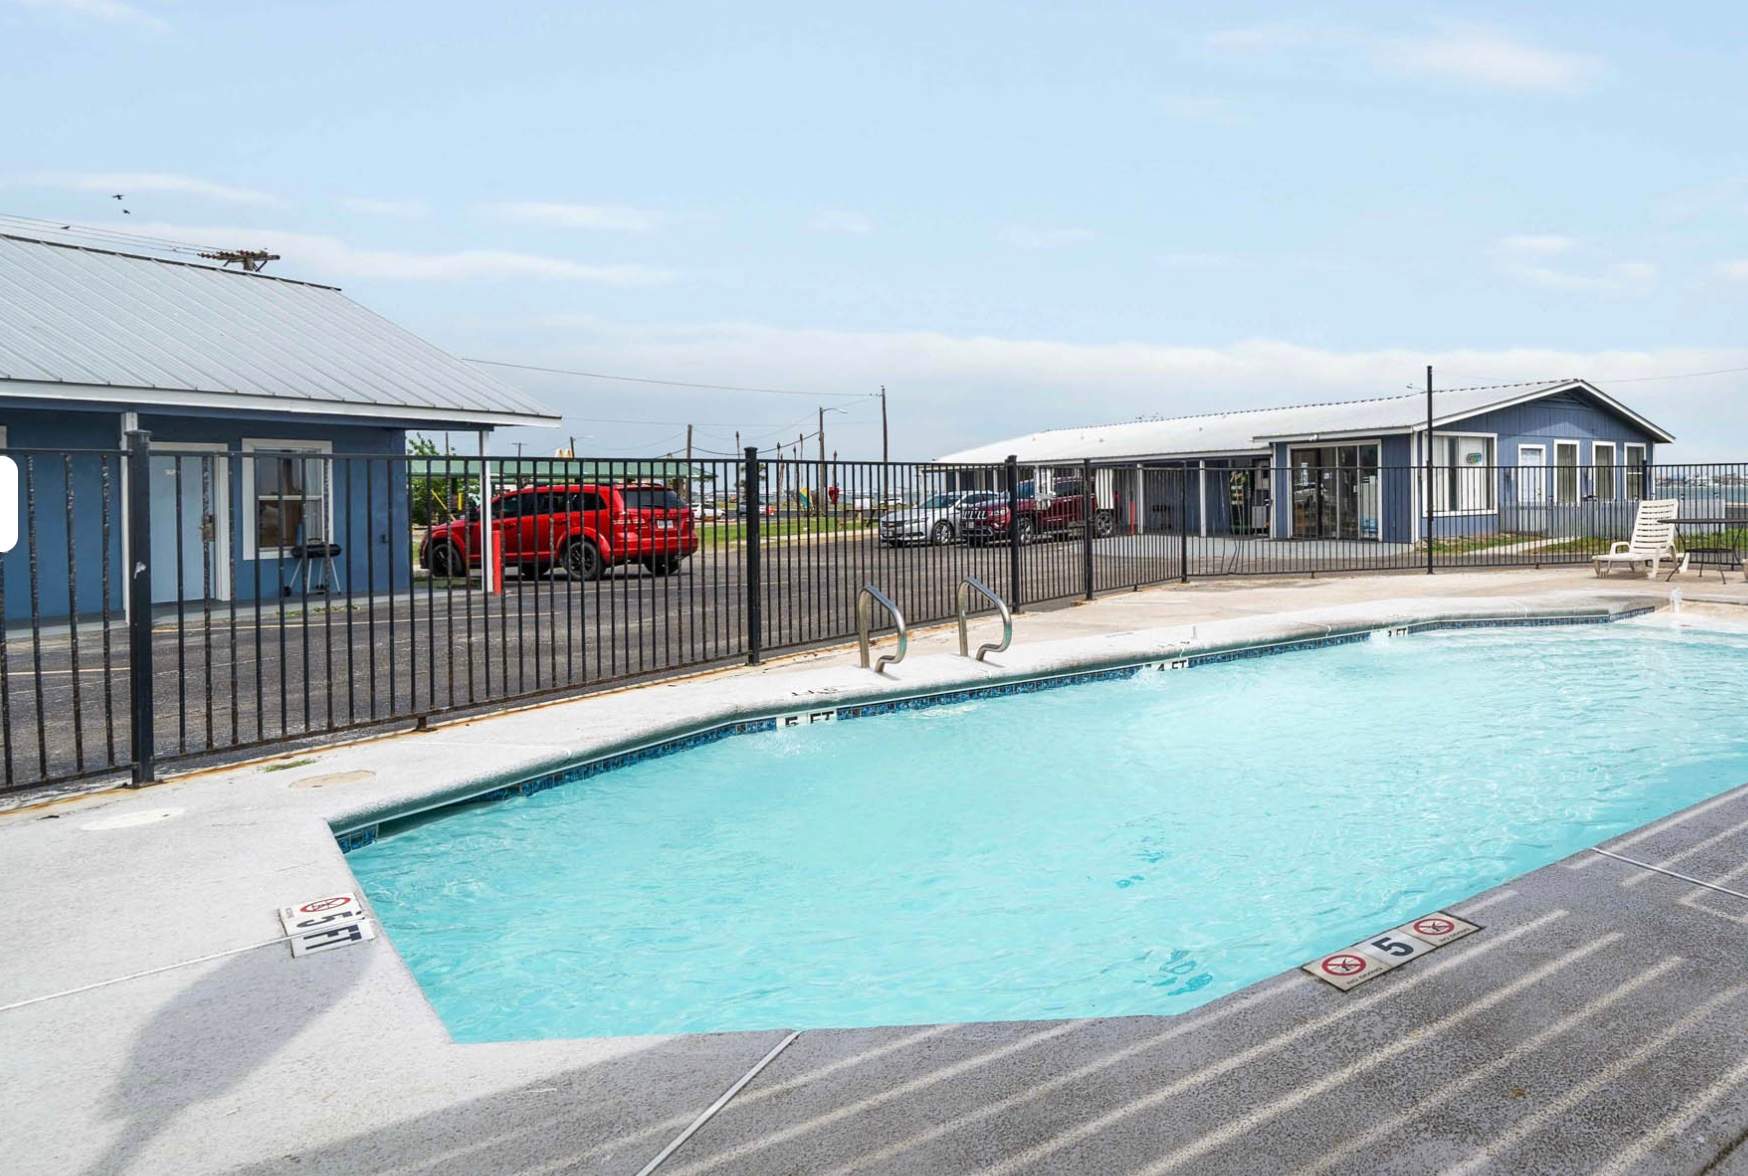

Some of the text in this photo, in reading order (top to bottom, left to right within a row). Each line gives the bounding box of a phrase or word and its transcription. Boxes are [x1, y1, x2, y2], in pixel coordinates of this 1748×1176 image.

[810, 711, 834, 724] FT
[303, 924, 362, 951] FT
[1371, 937, 1415, 957] 5
